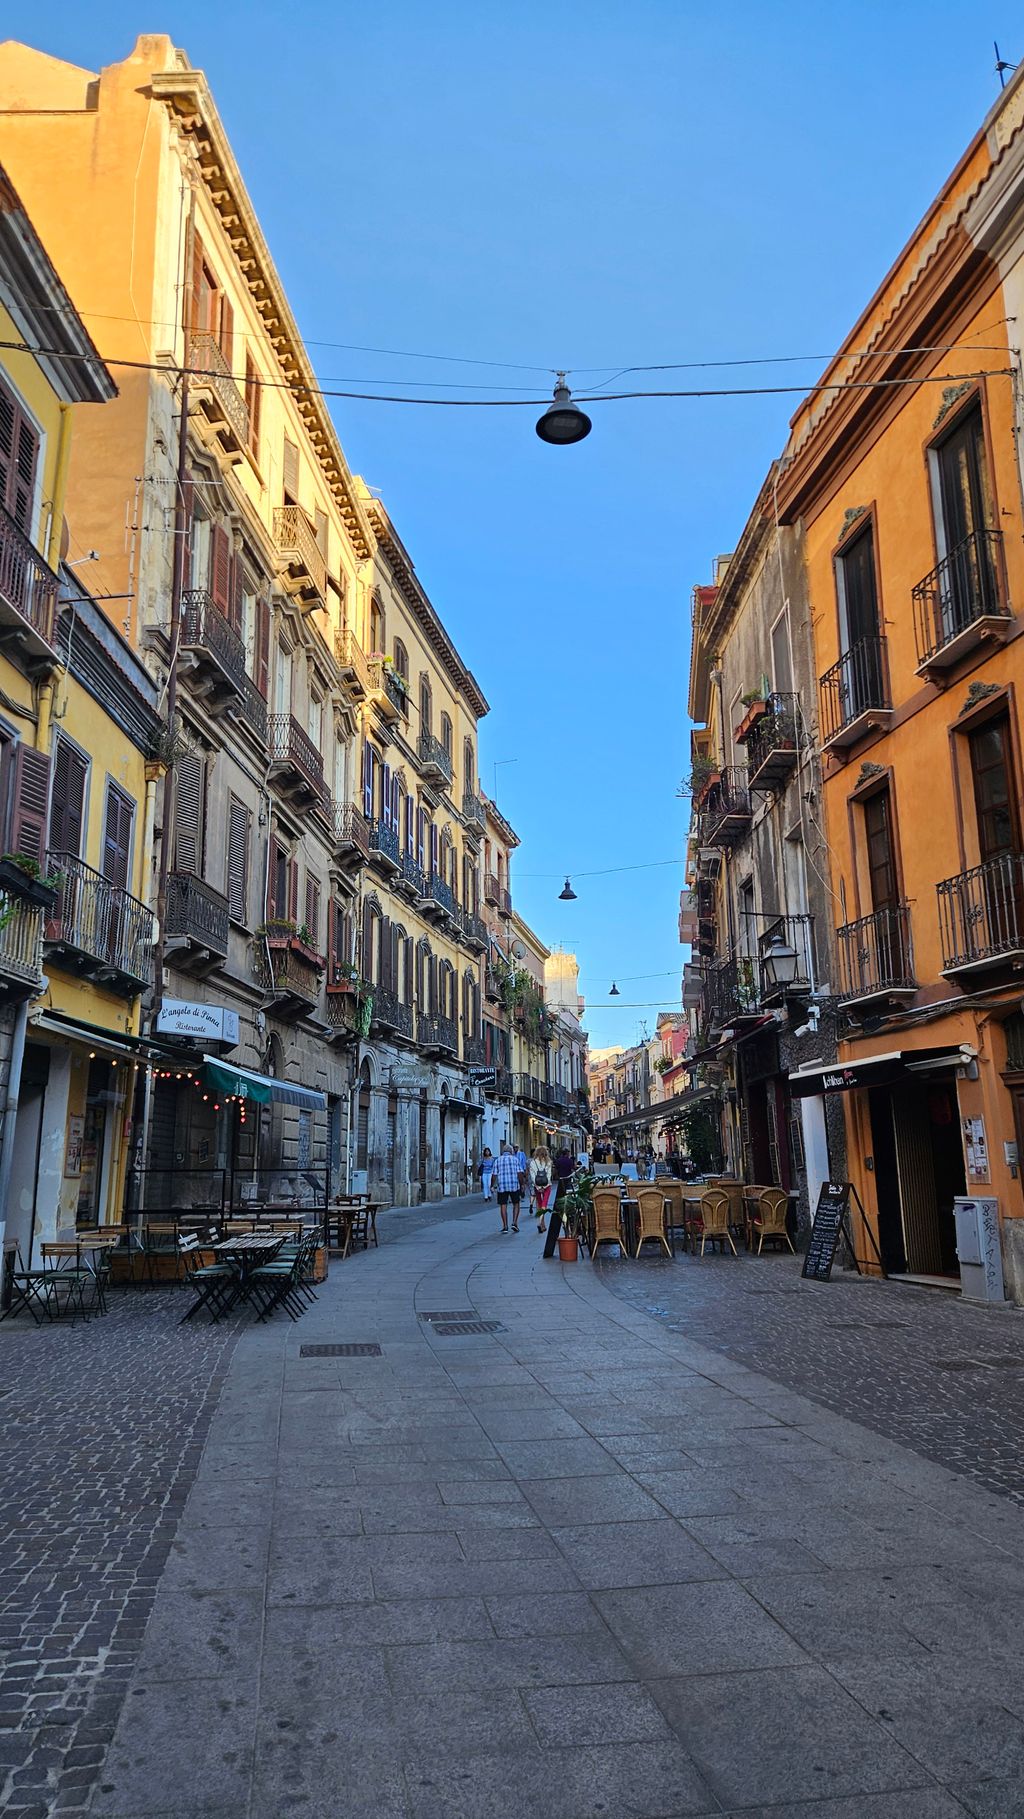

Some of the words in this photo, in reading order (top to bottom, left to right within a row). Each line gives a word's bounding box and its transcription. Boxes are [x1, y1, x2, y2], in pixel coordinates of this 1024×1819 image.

[161, 1005, 191, 1019] L'angolo
[192, 1007, 200, 1017] di
[175, 1021, 206, 1033] Ristorante
